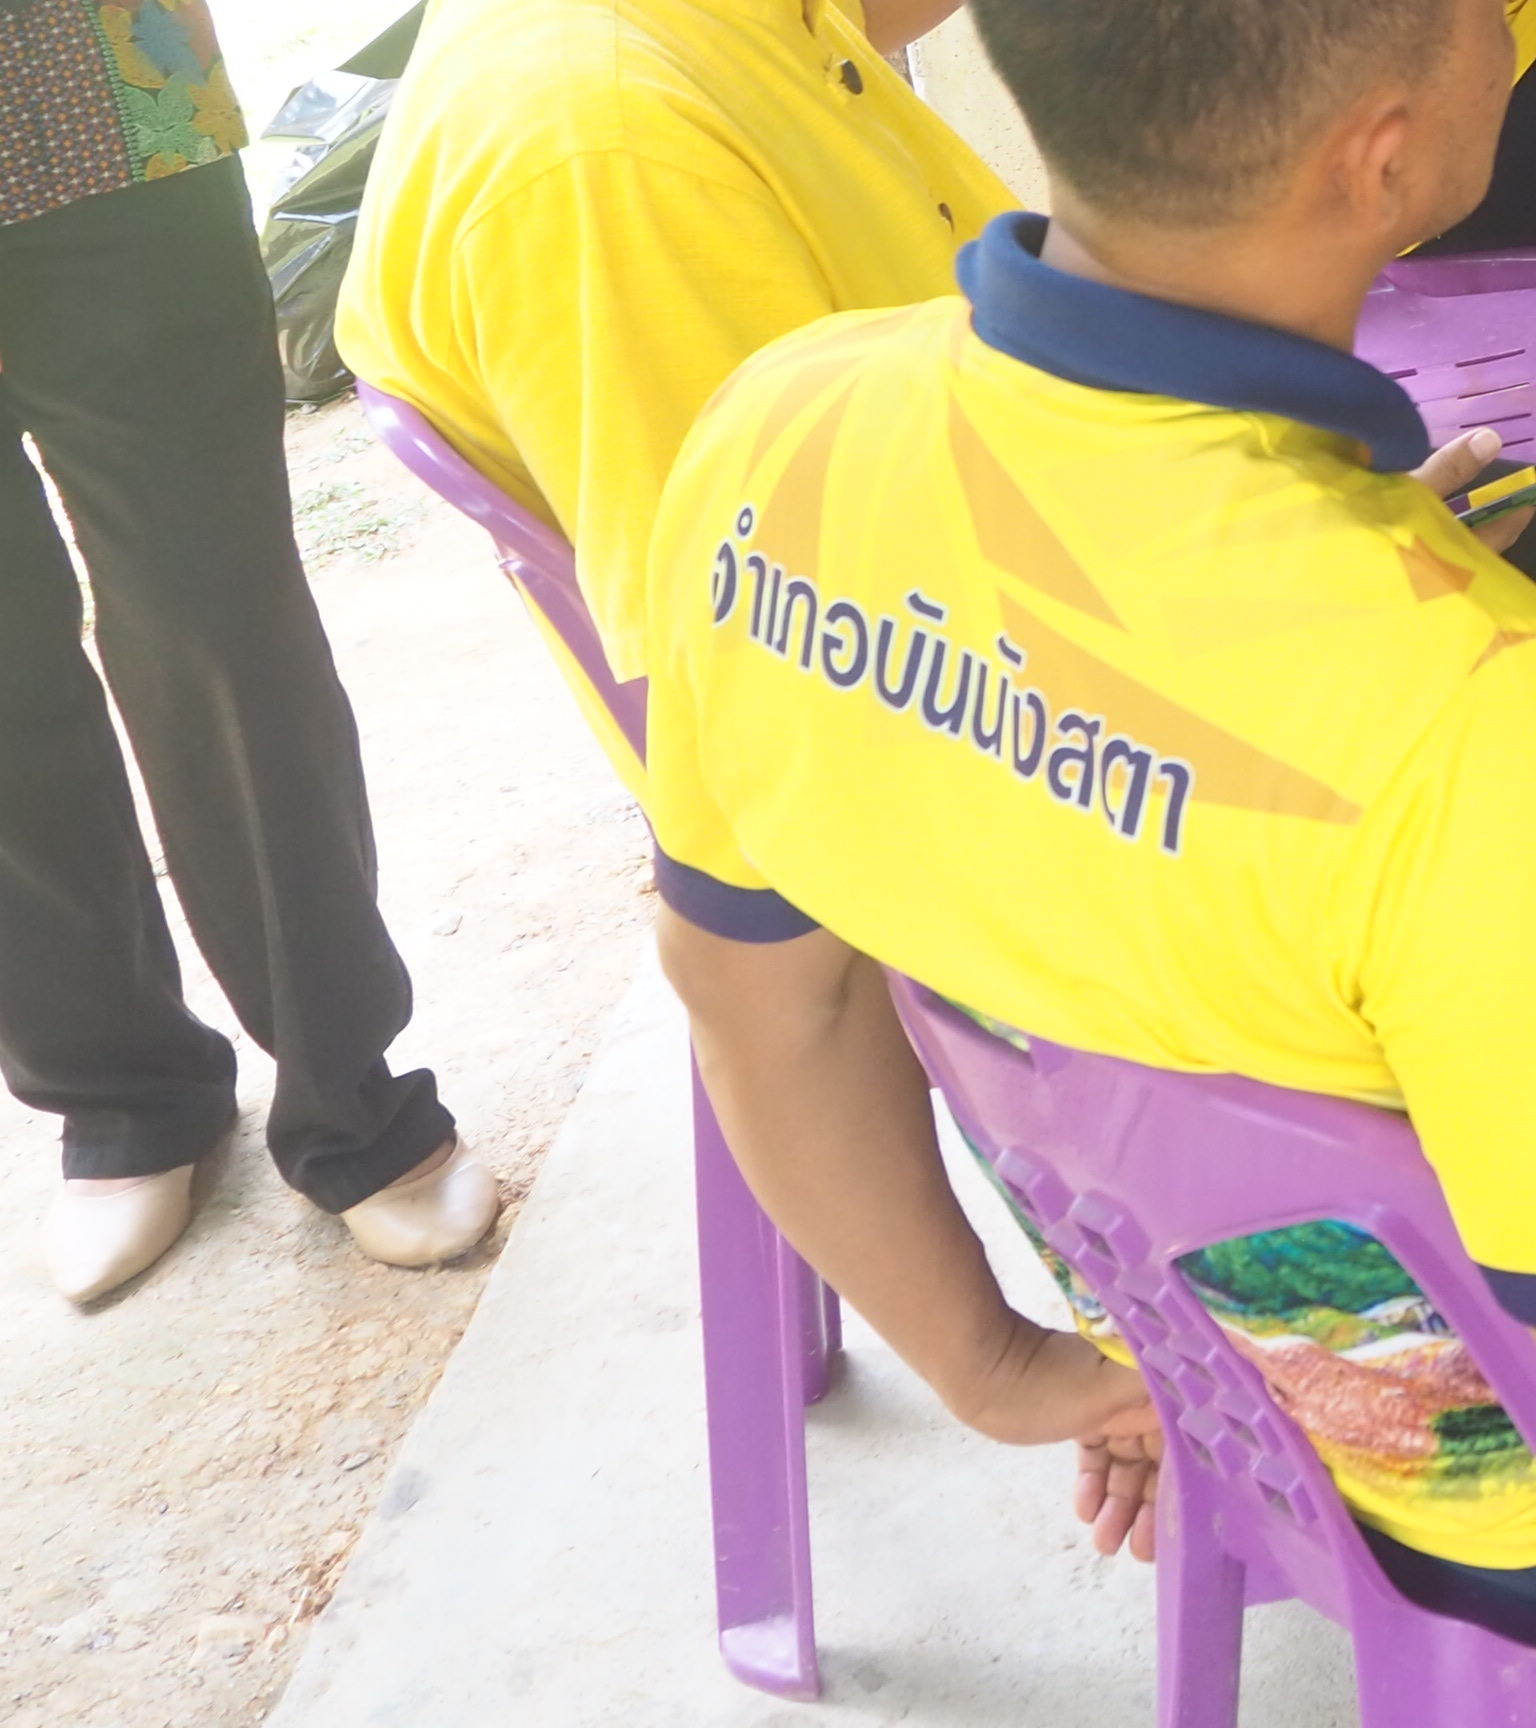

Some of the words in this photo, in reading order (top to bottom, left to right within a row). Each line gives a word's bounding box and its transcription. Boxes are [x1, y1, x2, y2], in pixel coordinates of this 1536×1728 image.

[711, 505, 1191, 853] อำเภอบันนังสตา
